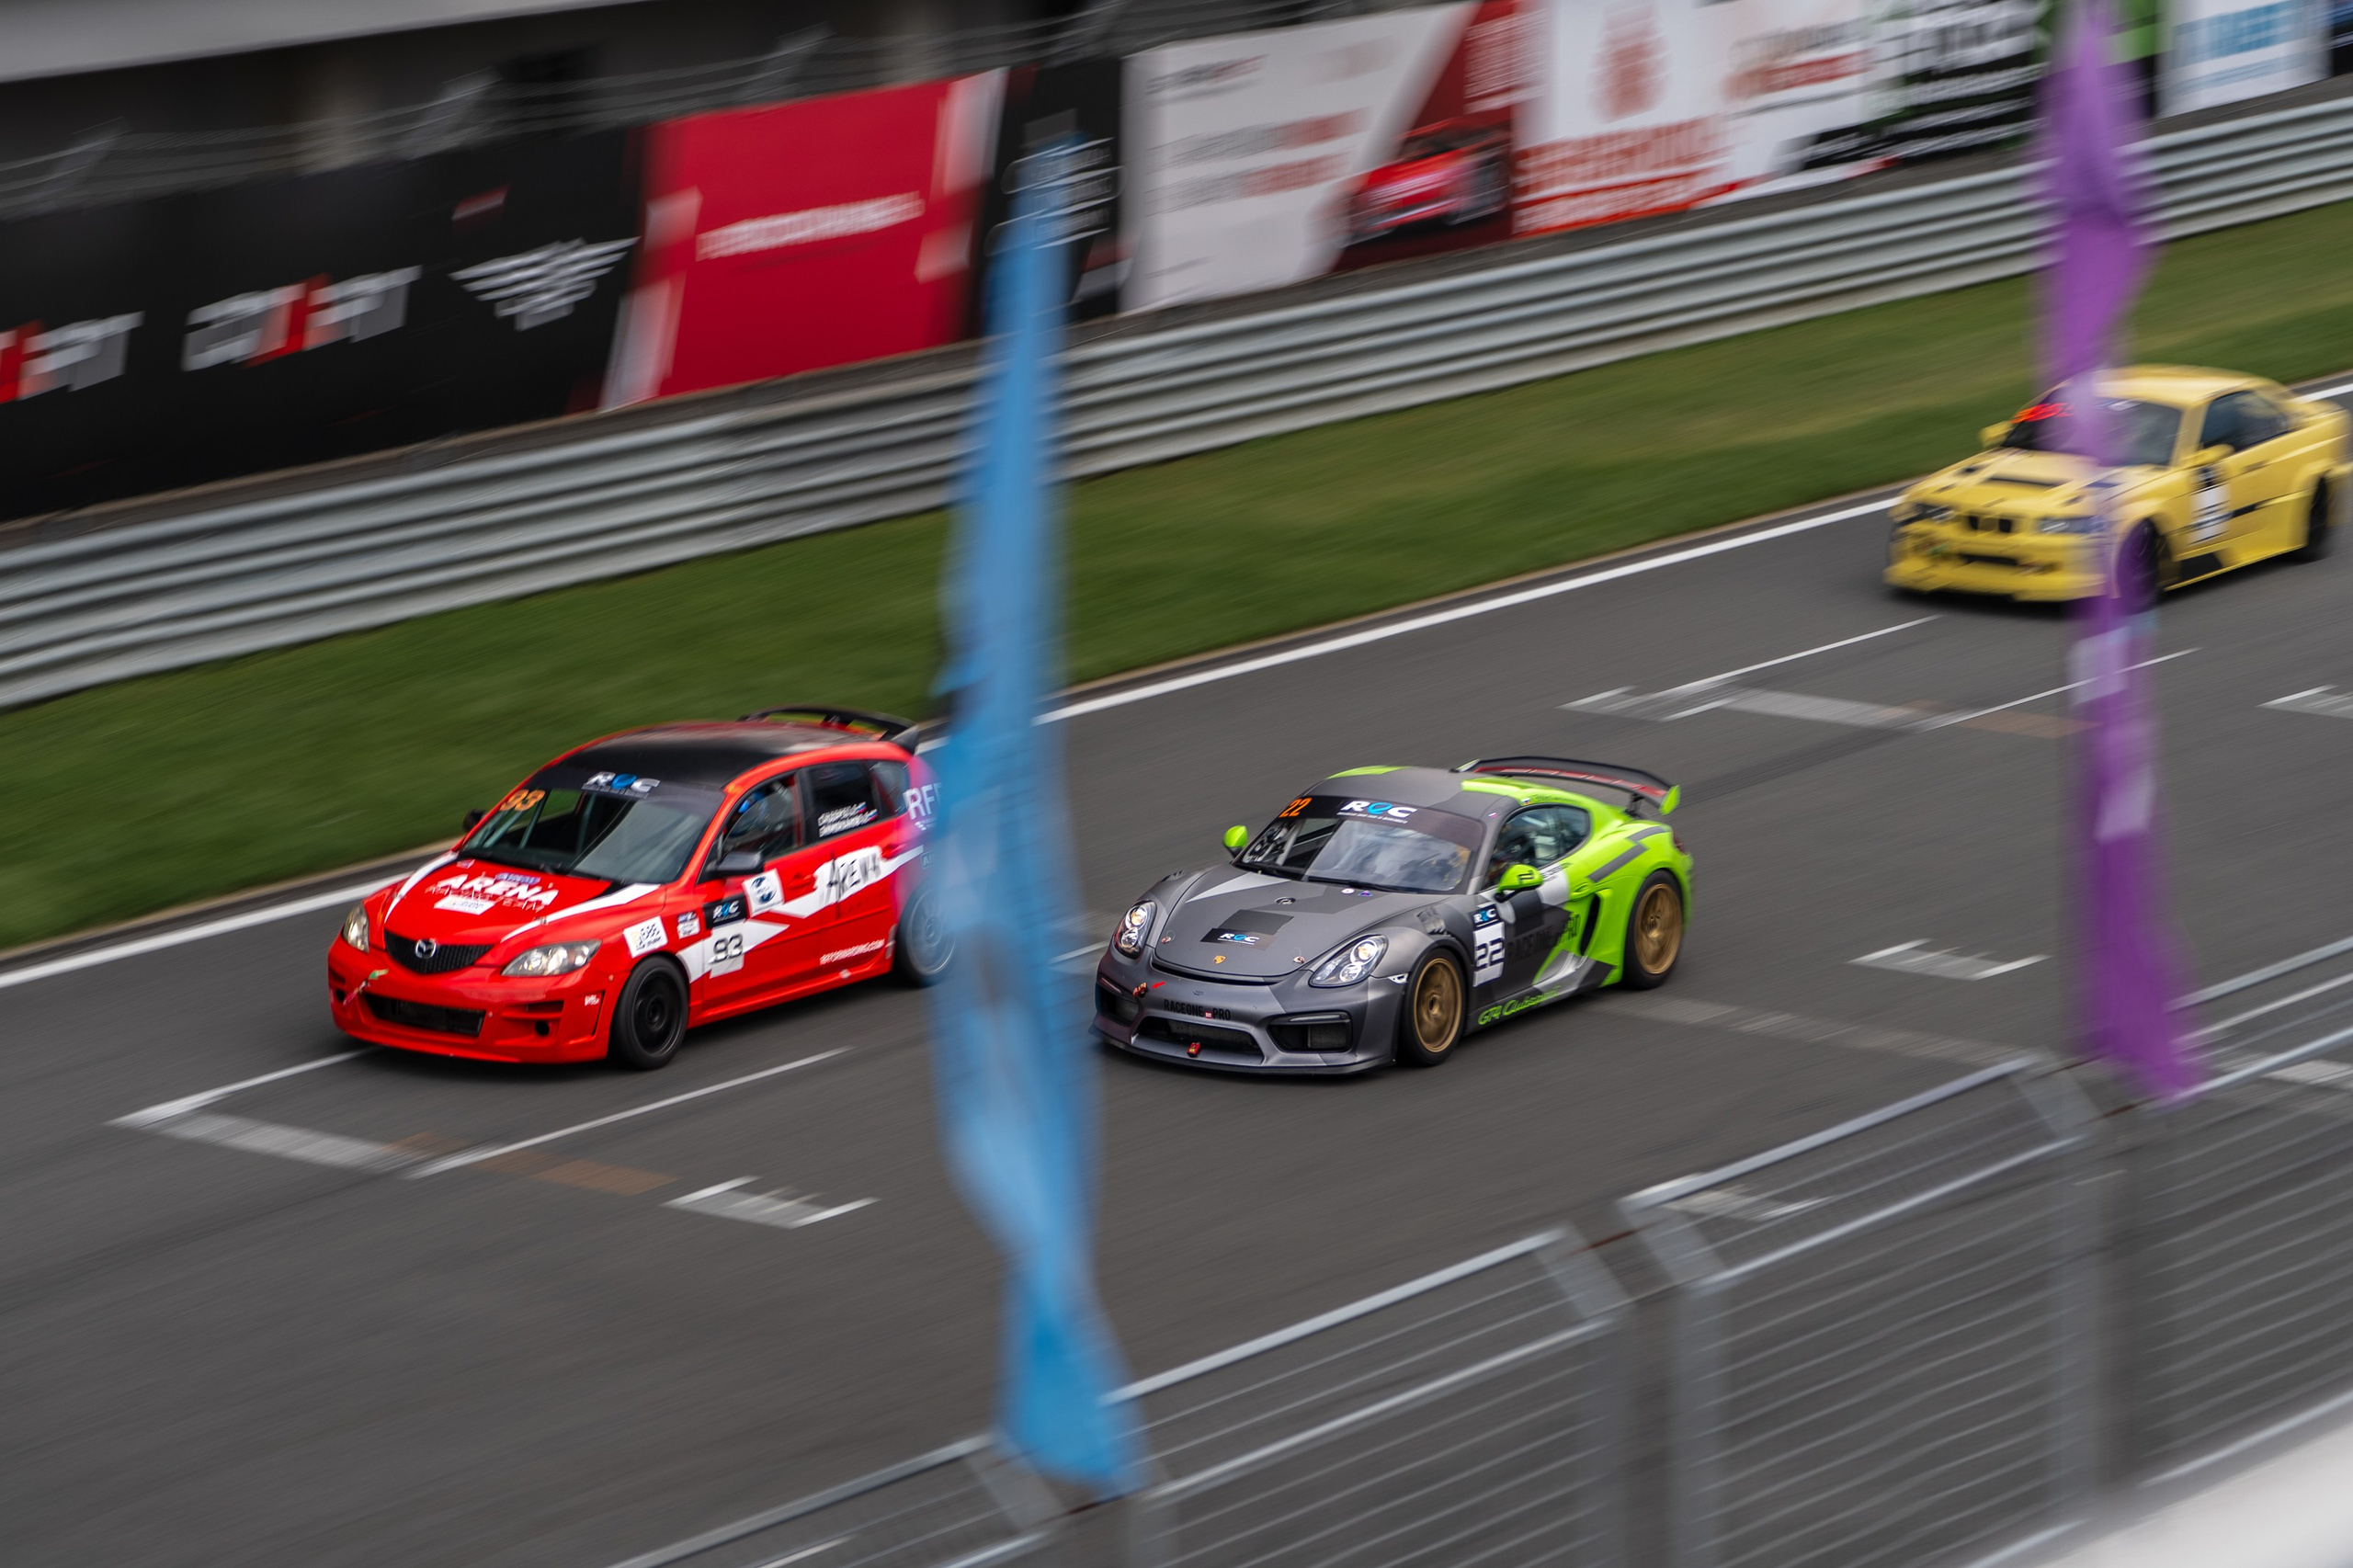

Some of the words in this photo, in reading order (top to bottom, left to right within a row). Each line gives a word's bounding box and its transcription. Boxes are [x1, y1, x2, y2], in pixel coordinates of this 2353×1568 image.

[499, 790, 546, 811] 93
[1278, 797, 1312, 818] 22
[437, 874, 560, 906] ARENA
[713, 933, 744, 964] 93
[1474, 937, 1505, 972] 22
